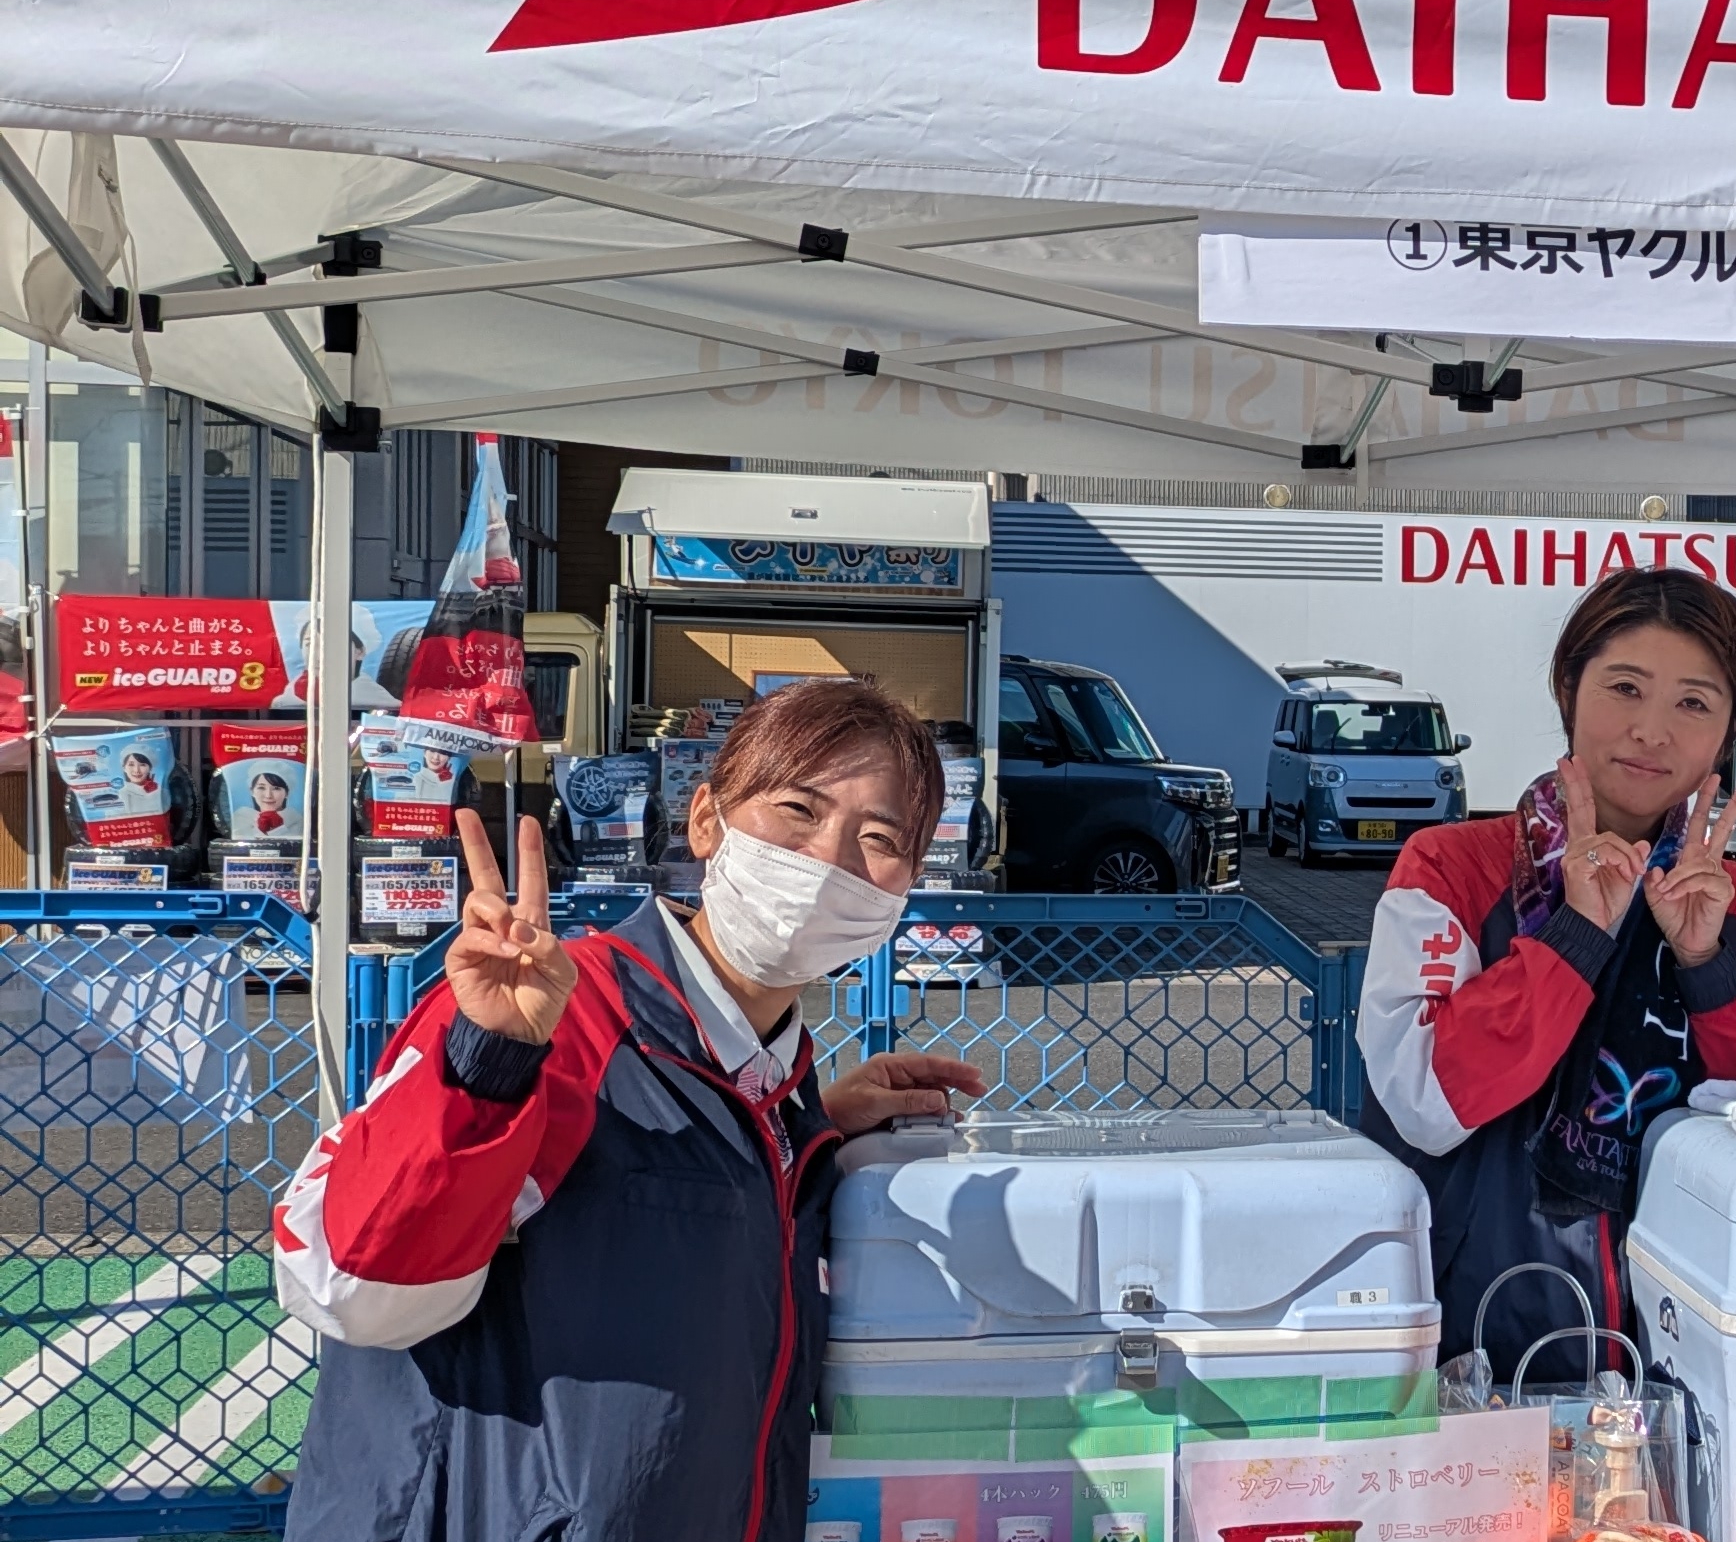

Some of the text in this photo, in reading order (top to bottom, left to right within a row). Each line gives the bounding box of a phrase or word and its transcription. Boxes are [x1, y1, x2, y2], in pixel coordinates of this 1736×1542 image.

[1368, 1290, 1377, 1303] 3
[1237, 1462, 1500, 1501] ソフール ストロベリー
